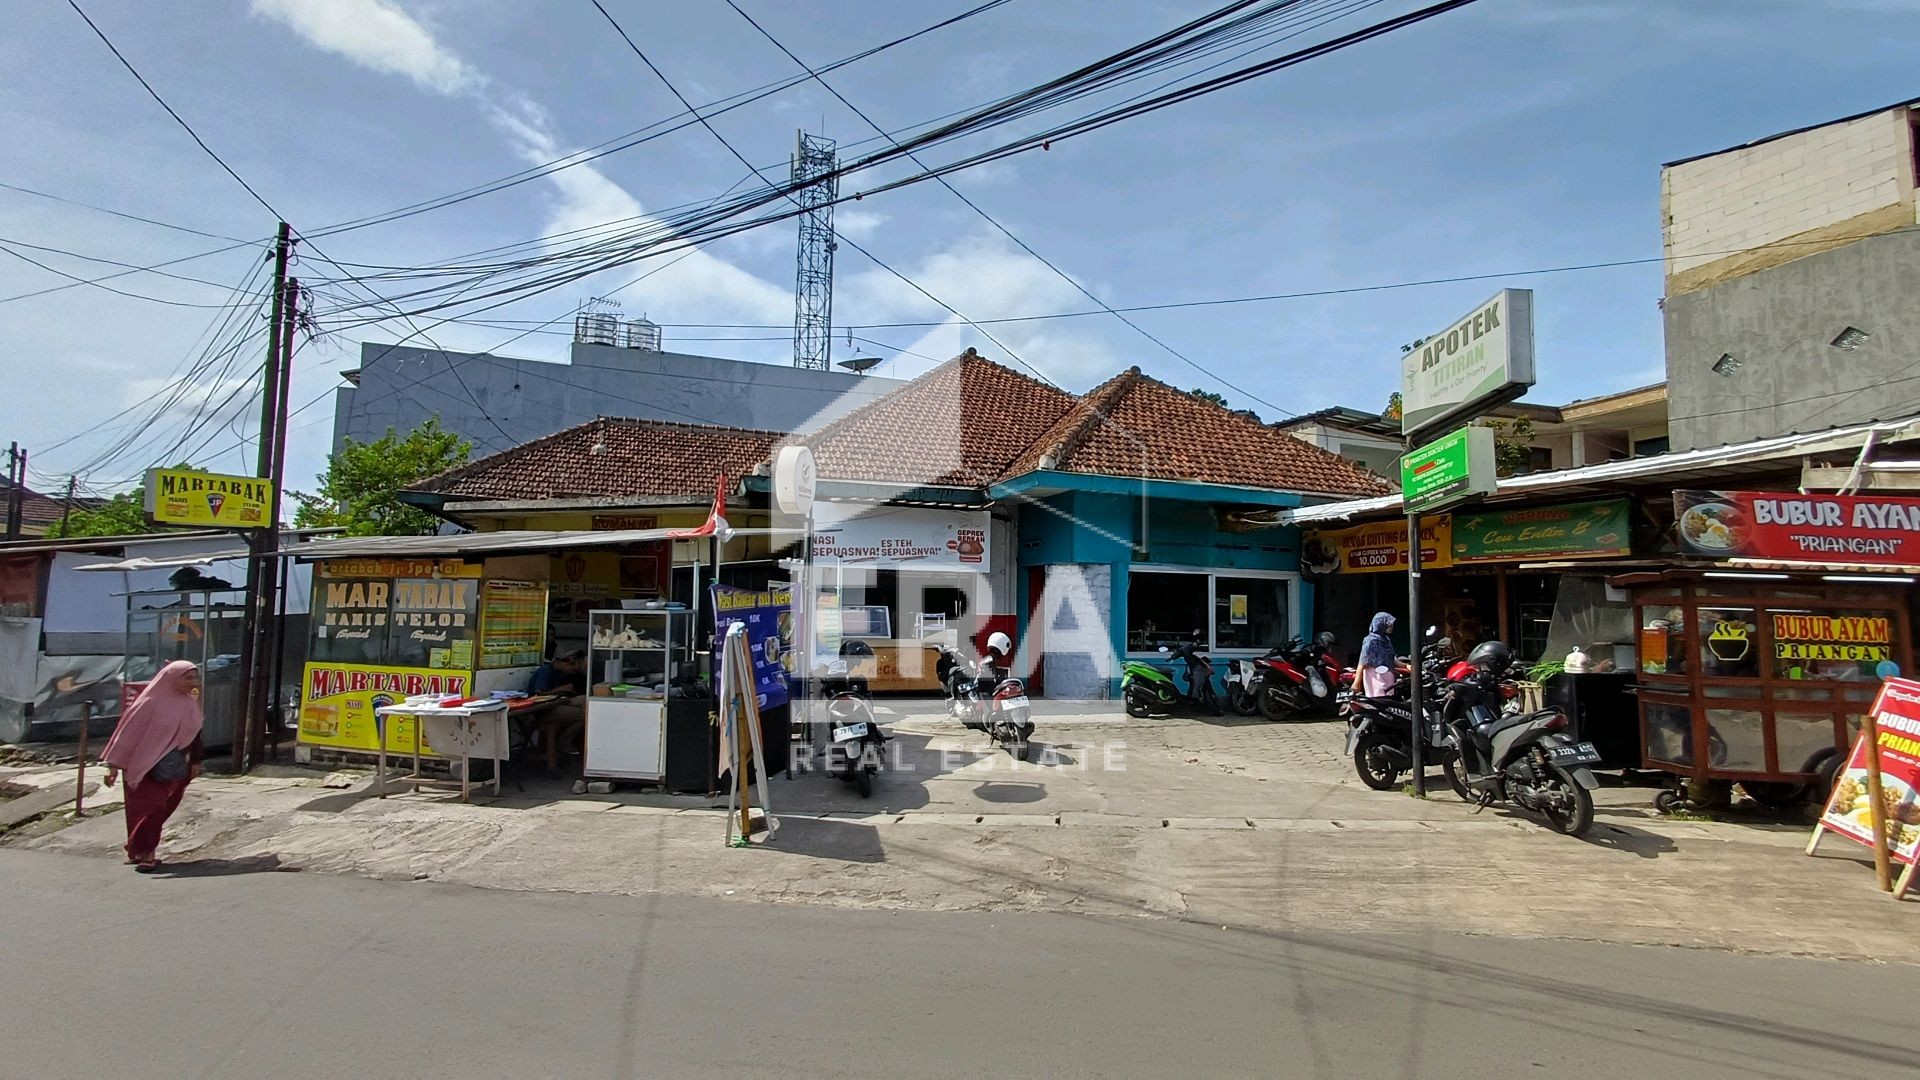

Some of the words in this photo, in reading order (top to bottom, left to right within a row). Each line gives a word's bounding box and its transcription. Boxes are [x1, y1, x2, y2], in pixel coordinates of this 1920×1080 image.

[1422, 301, 1500, 372] APOTEK
[1433, 342, 1485, 387] TITIRAN
[161, 475, 266, 505] MARTABAK
[1753, 499, 1844, 527] BUBUR
[812, 536, 835, 545] NASI
[812, 547, 880, 557] SEPUASNYA!
[881, 539, 892, 548] ES
[895, 539, 912, 548] TEH
[1359, 555, 1387, 566] 10.000
[326, 582, 389, 609] MAR
[398, 582, 468, 610] TABAK
[325, 612, 387, 626] MANIS
[395, 613, 466, 627] TELOR
[1773, 615, 1834, 641] BUBUR
[1838, 616, 1889, 643] AYAM
[1776, 643, 1889, 660] PRIANGAN
[309, 669, 467, 701] MARTABAK
